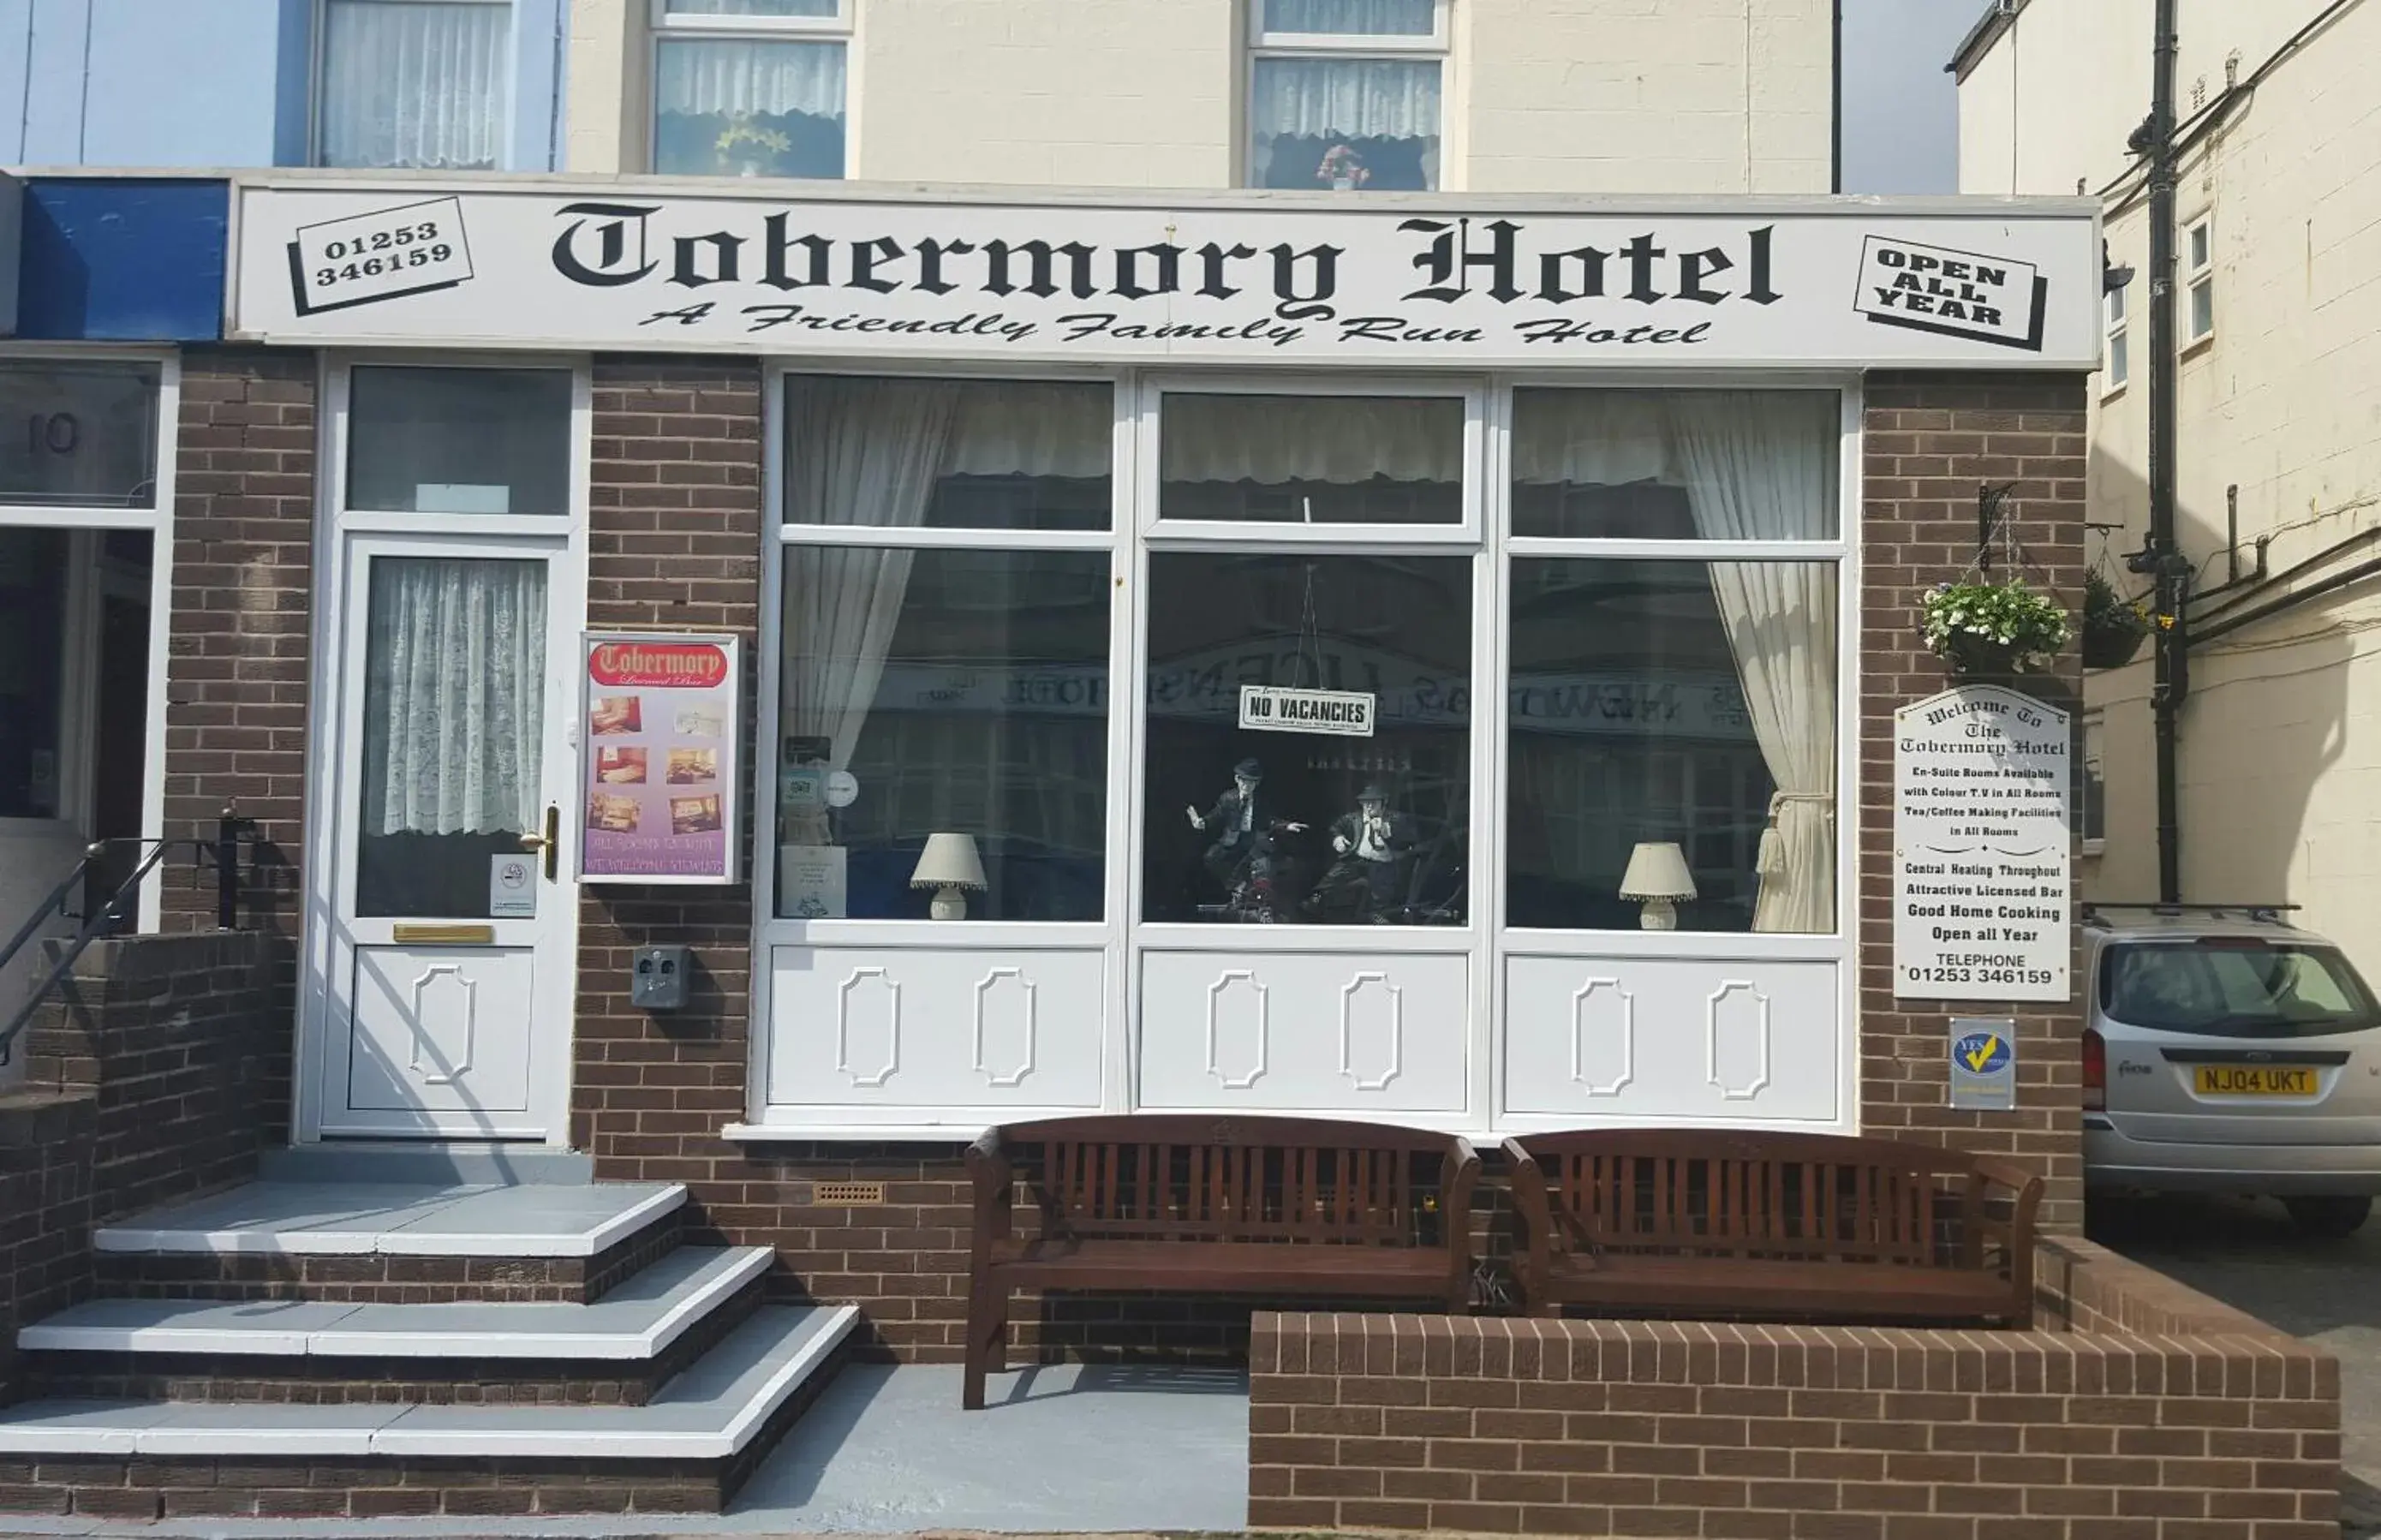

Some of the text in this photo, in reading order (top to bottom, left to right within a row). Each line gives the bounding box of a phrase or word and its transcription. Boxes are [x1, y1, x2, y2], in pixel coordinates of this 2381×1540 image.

[325, 222, 439, 260] 01253
[317, 244, 451, 286] 346159
[552, 202, 1784, 321] Tobermory Hotel
[1877, 248, 2007, 286] OPEN
[1893, 272, 1987, 303] ALL
[1873, 287, 2002, 325] YEAR
[638, 301, 1712, 347] A Friendly Family Run Hotel
[600, 644, 720, 680] Tobermory
[1250, 696, 1365, 723] NO VACANCIES
[1925, 701, 2042, 728] Welcome To
[1966, 724, 2002, 739] The
[1901, 738, 2065, 756] Tobermory Hotel
[1913, 767, 2054, 779] En-Suite Rooms Available
[1904, 787, 1928, 797] with
[1931, 788, 1966, 797] Colour
[1992, 788, 2002, 797] in
[2006, 788, 2021, 798] All
[2025, 789, 2062, 798] Rooms
[1905, 806, 2062, 819] Tea/Coffee Making Facilities
[1950, 827, 2019, 837] in All Rooms
[1906, 863, 2061, 879] Central Heating Throughout
[1907, 884, 2063, 898] Attractive Licensed Bar
[1907, 904, 2060, 922] Good Home Cooking
[1932, 927, 2038, 942] Open all Year
[1936, 953, 2026, 968] TELEPHONE
[1909, 967, 2052, 984] 01253 346159
[2205, 1070, 2308, 1091] NJ04 UKT
